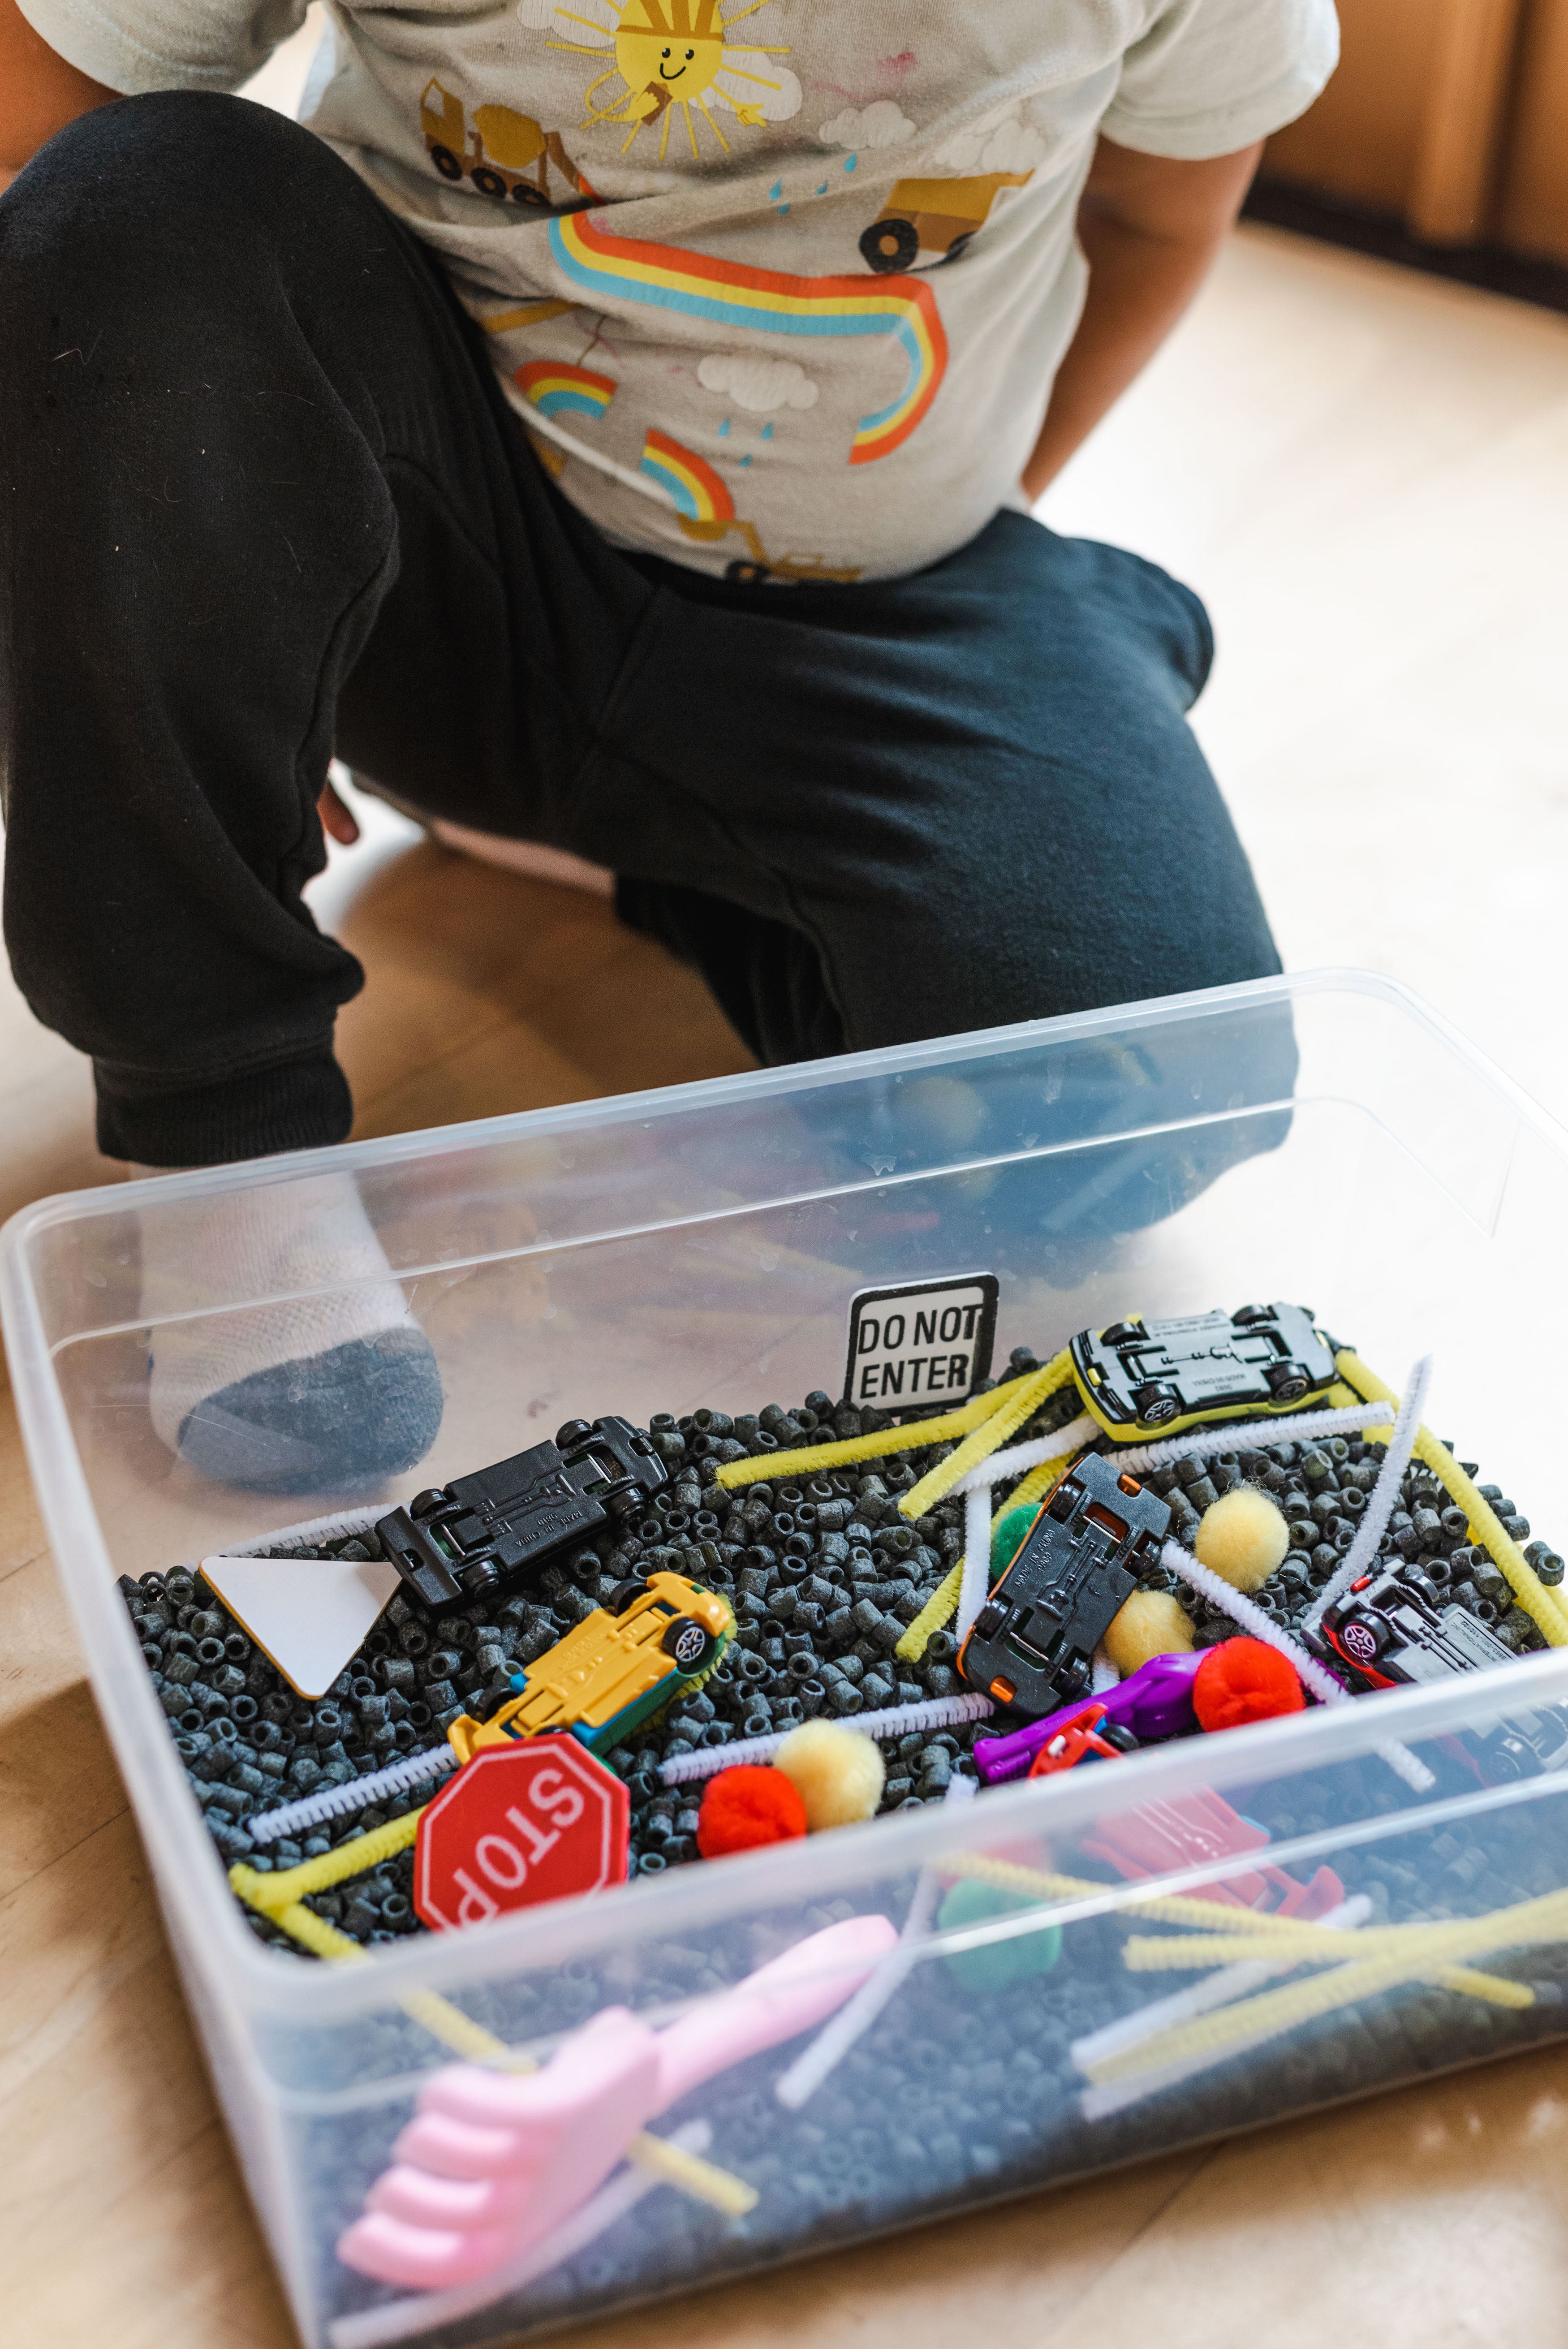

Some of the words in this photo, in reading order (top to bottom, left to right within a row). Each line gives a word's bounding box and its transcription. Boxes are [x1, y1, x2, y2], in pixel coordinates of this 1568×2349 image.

[858, 1314, 905, 1355] DO
[913, 1303, 984, 1346] NOT
[859, 1353, 970, 1399] ENTER
[515, 1531, 541, 1547] CHINA
[544, 1524, 555, 1533] IN
[558, 1510, 582, 1527] MADE
[1014, 1564, 1032, 1589] MADE
[1030, 1552, 1039, 1564] IN
[1037, 1528, 1056, 1552] CHINA
[453, 1768, 585, 1926] STOP
